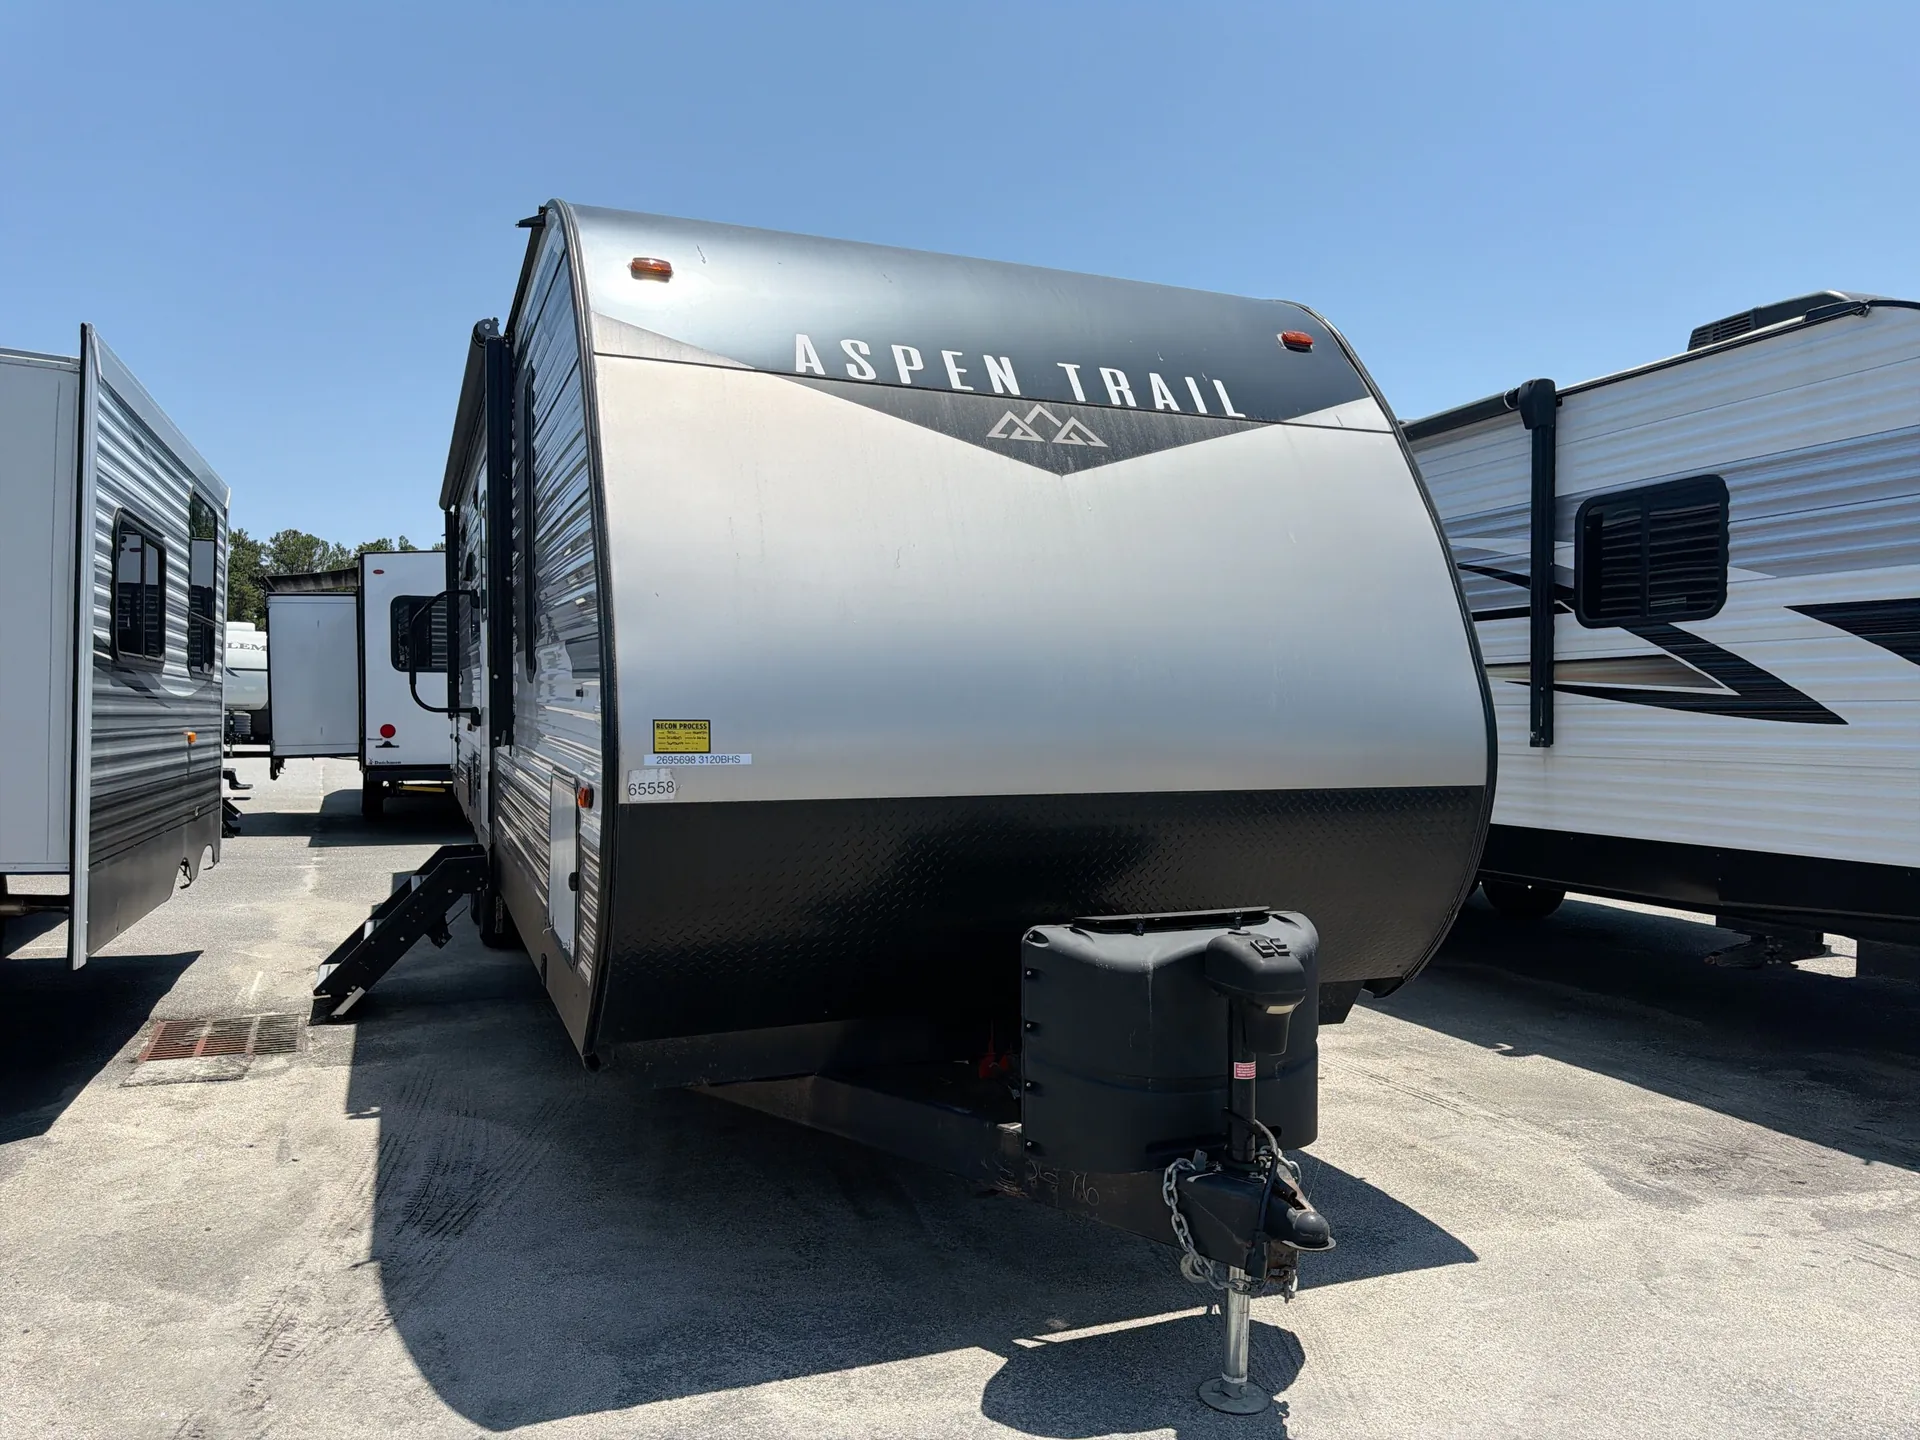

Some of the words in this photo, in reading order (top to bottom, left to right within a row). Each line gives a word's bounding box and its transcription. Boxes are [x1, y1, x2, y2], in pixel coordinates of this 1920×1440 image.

[795, 333, 1020, 396] ASPEN
[1057, 362, 1246, 418] TRAIL
[656, 722, 677, 730] RECON
[679, 722, 708, 730] PROCESS
[656, 755, 697, 765] 2695698
[698, 754, 741, 764] 3120BHS
[628, 780, 675, 796] 65558
